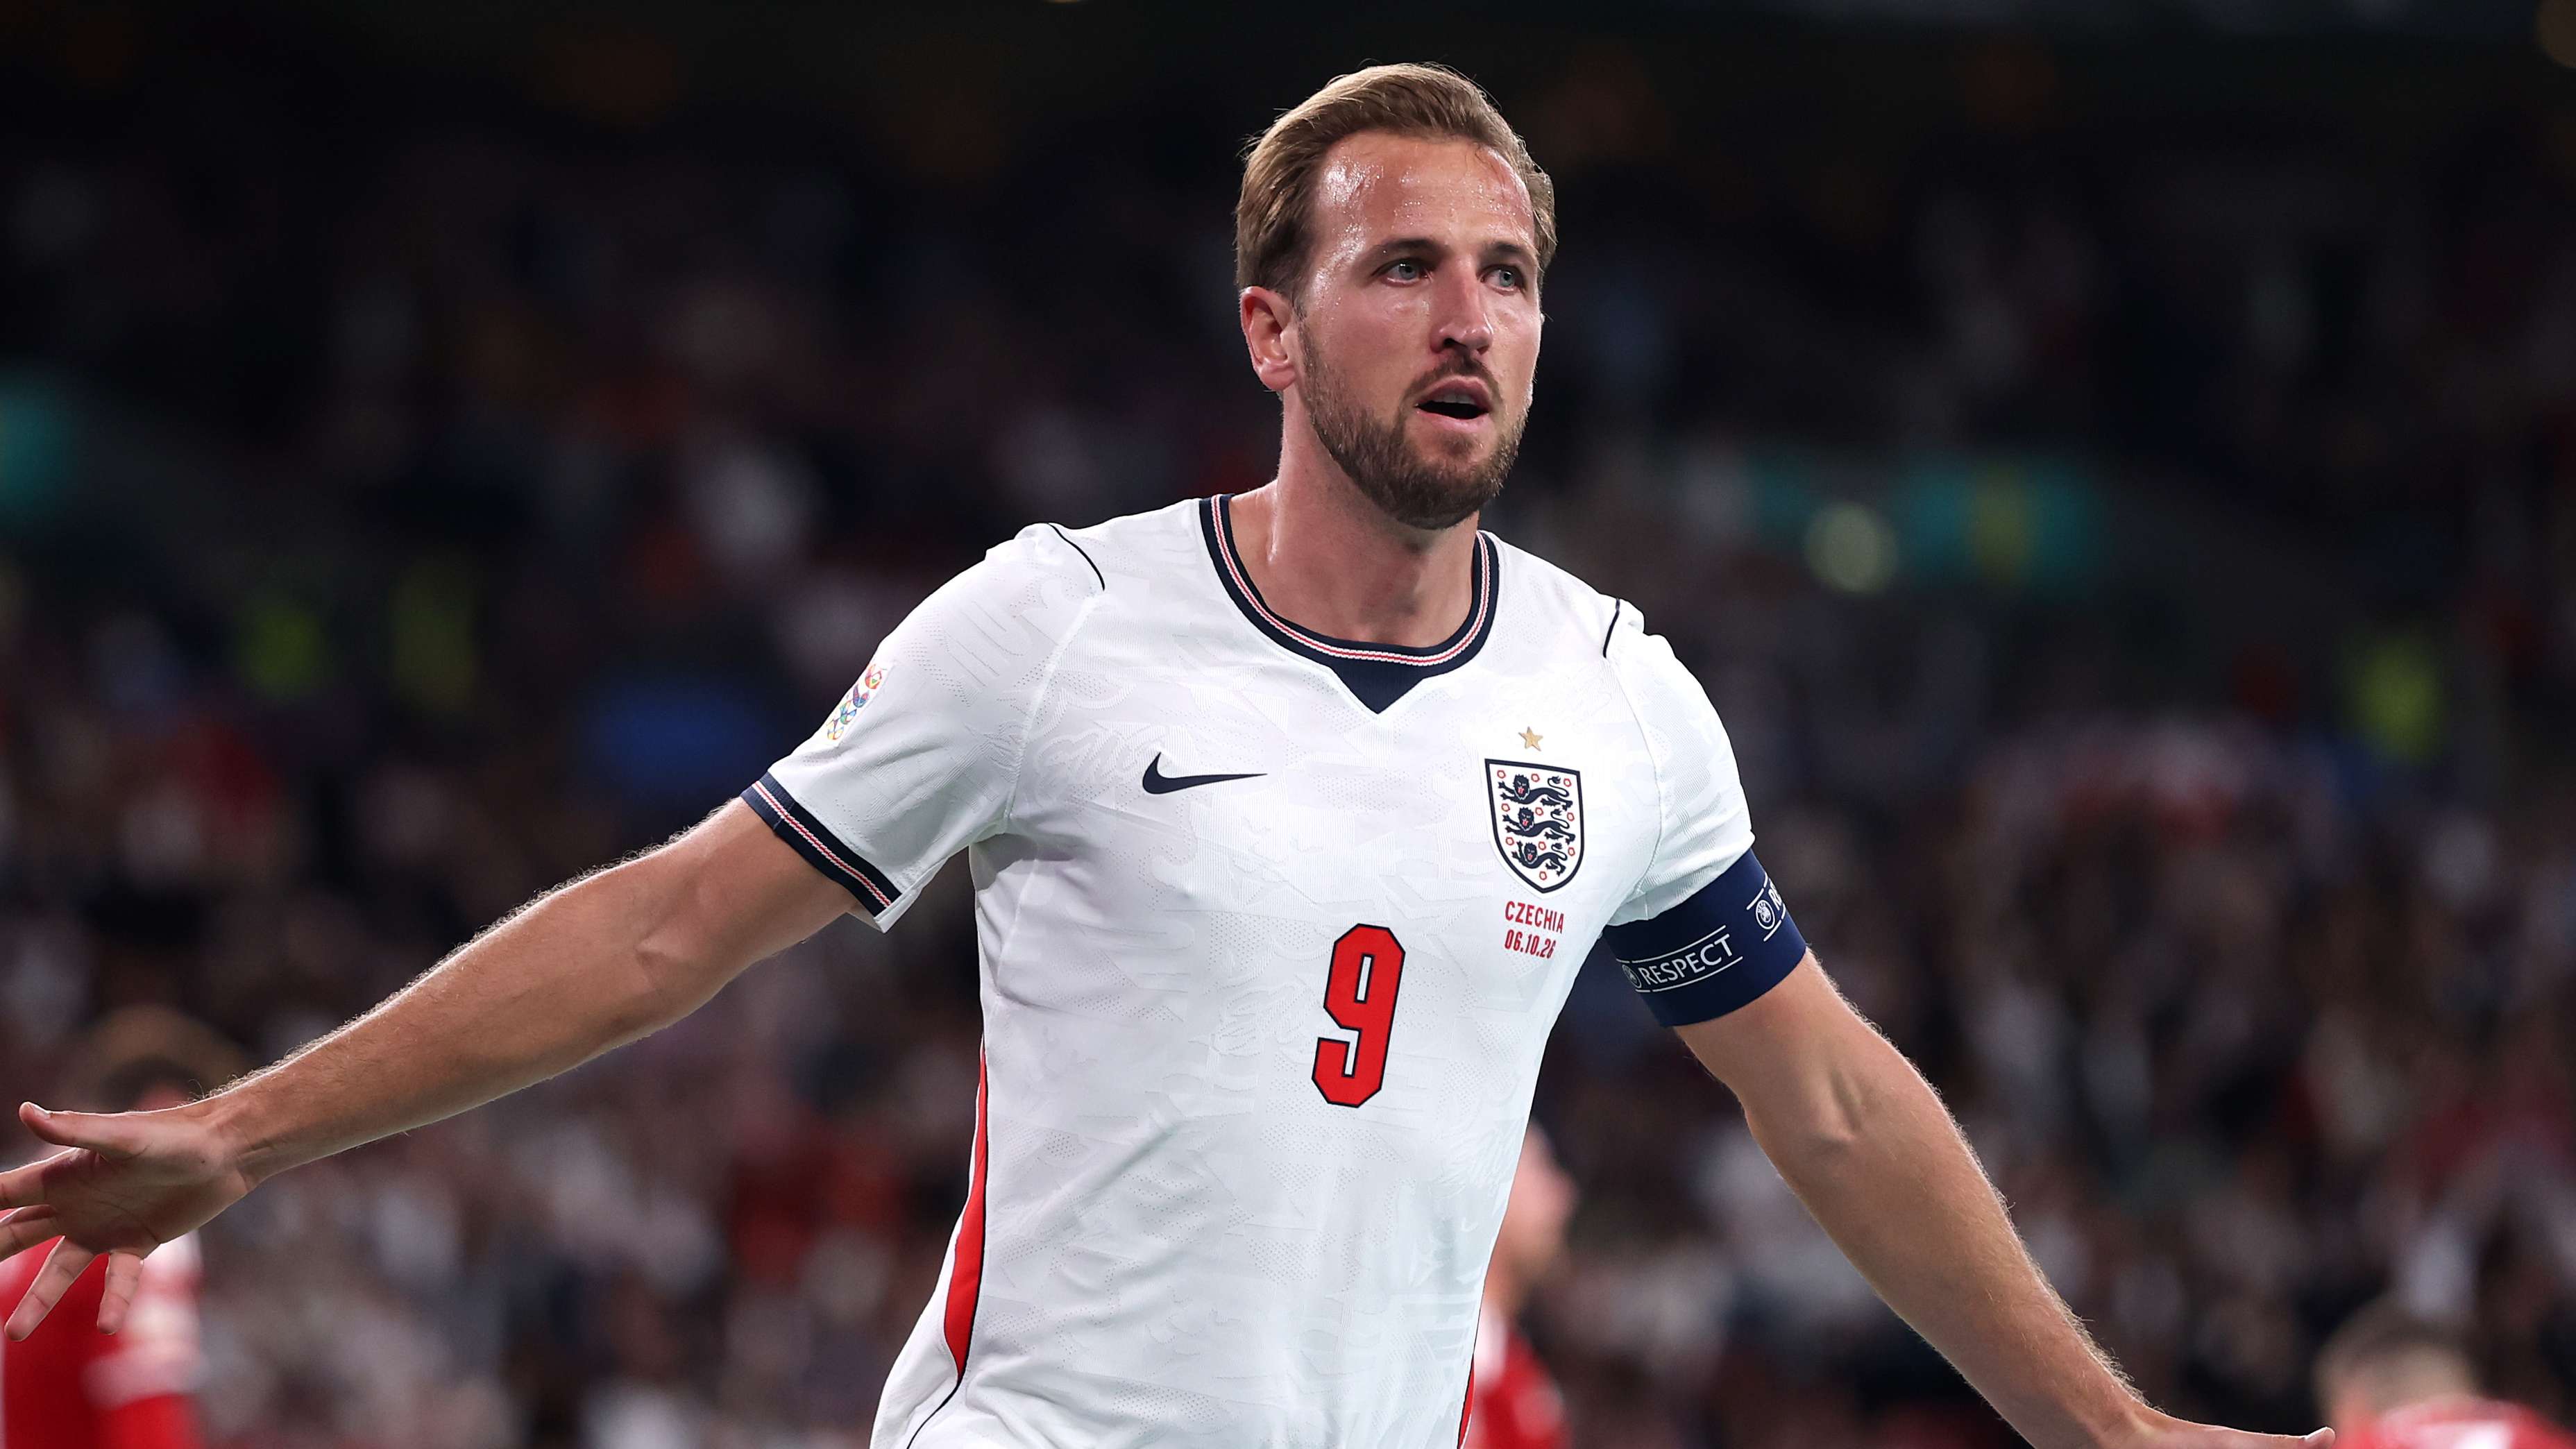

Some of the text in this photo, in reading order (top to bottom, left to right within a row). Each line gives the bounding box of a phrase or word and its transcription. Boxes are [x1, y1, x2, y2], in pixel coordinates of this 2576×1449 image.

[1505, 901, 1564, 933] CZECHIA
[1505, 929, 1556, 958] 06.10.26
[1638, 933, 1732, 985] RESPECT
[1312, 923, 1405, 1108] 9
